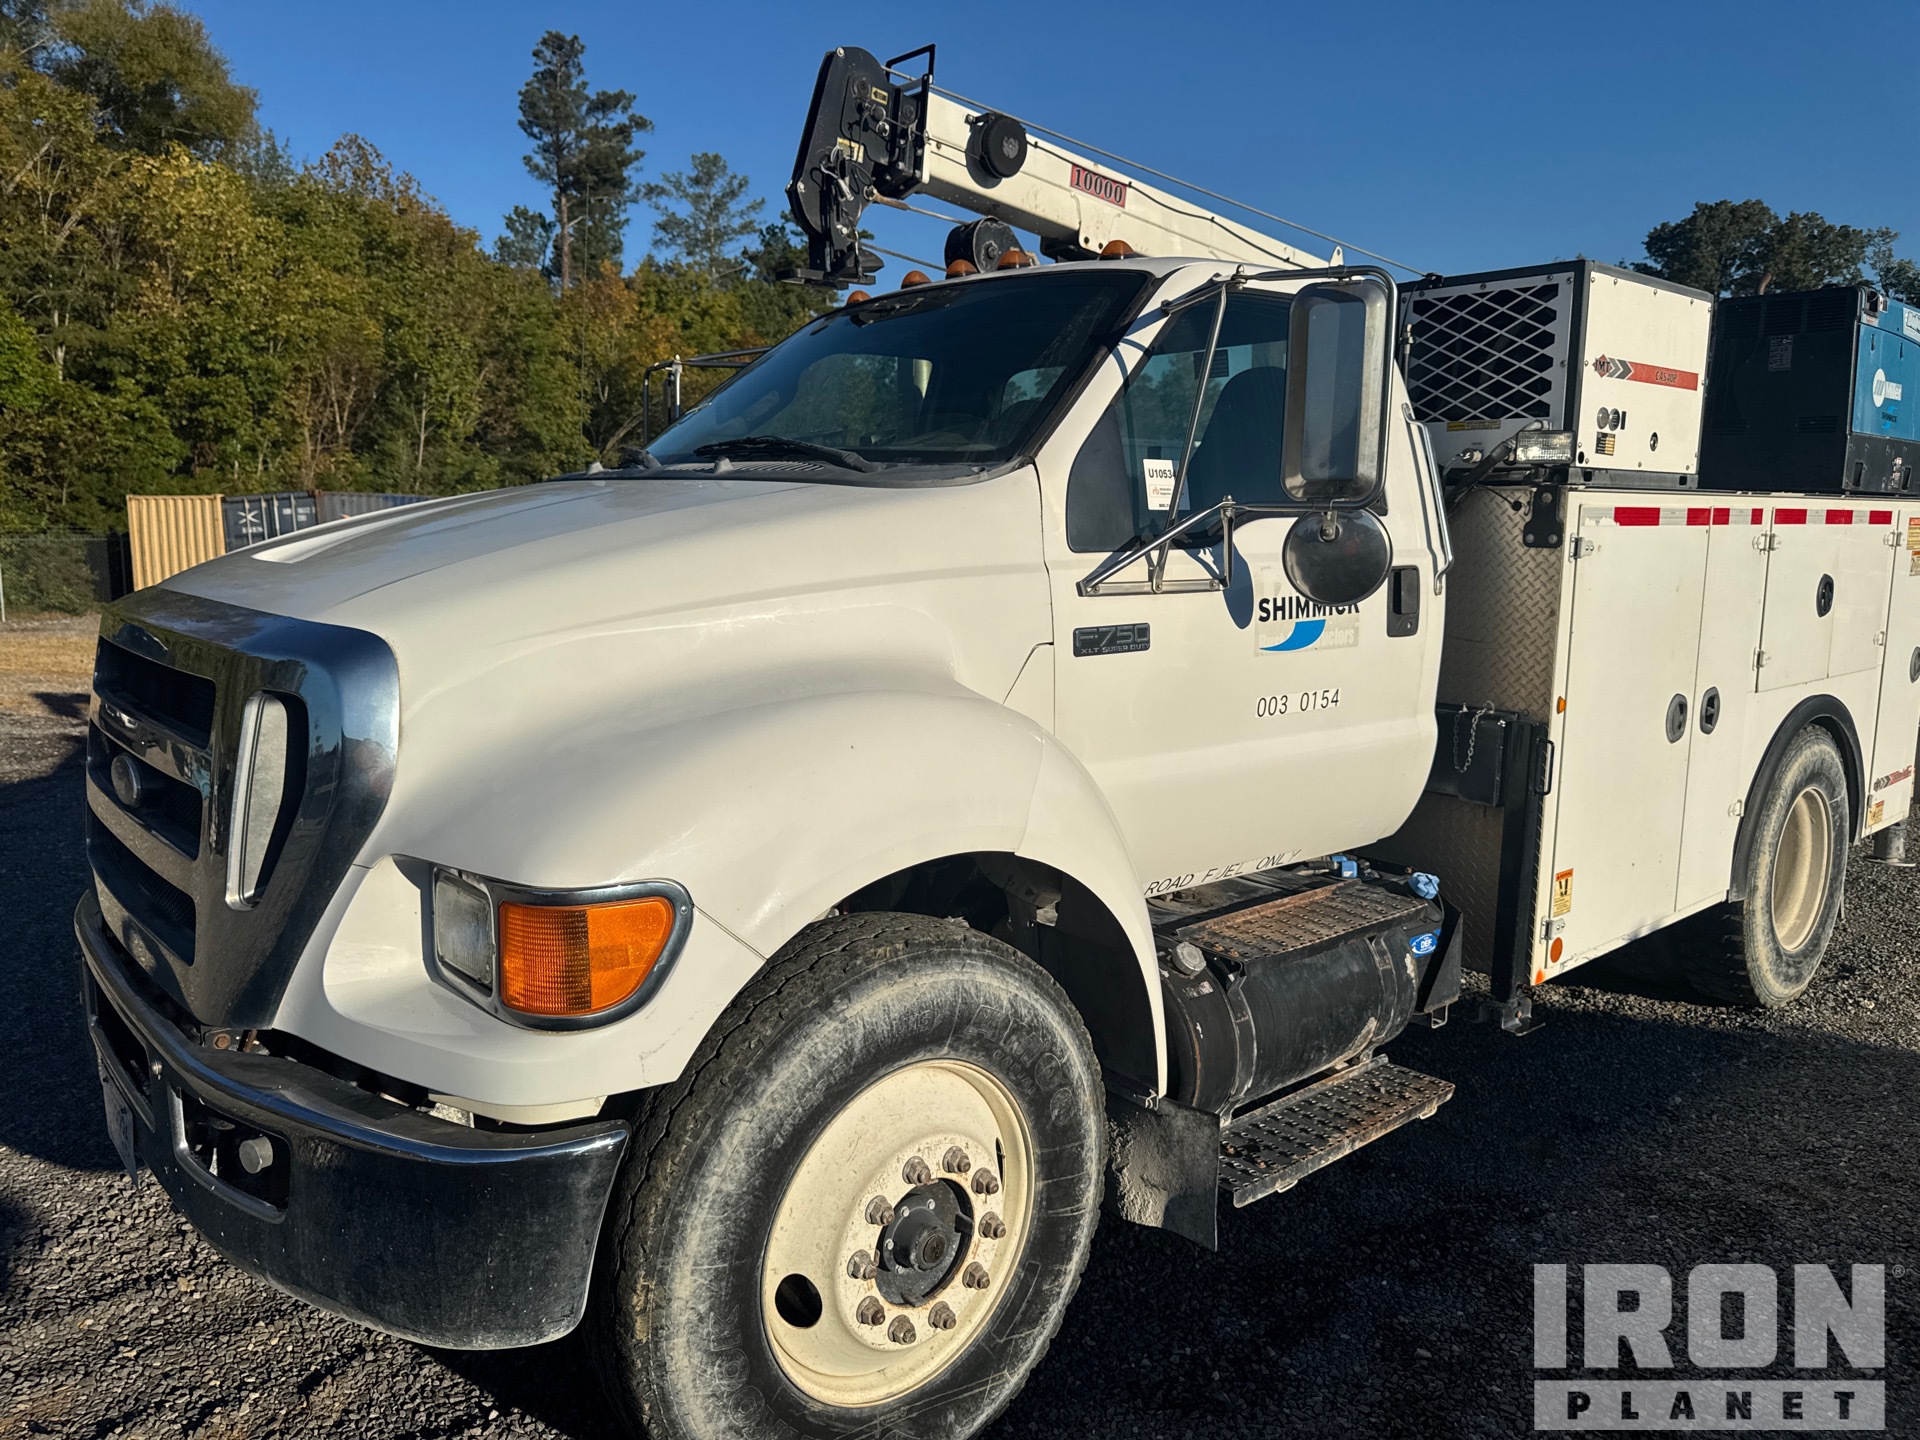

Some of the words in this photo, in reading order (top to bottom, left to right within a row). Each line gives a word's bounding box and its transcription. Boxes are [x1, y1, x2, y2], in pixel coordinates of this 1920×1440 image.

[1074, 168, 1123, 204] 10000
[1594, 358, 1611, 373] IMT
[1102, 644, 1129, 653] SUPER
[1130, 643, 1150, 651] DUTY
[1257, 694, 1288, 717] 003
[1300, 688, 1340, 712] 0154
[1144, 873, 1195, 896] ROAD
